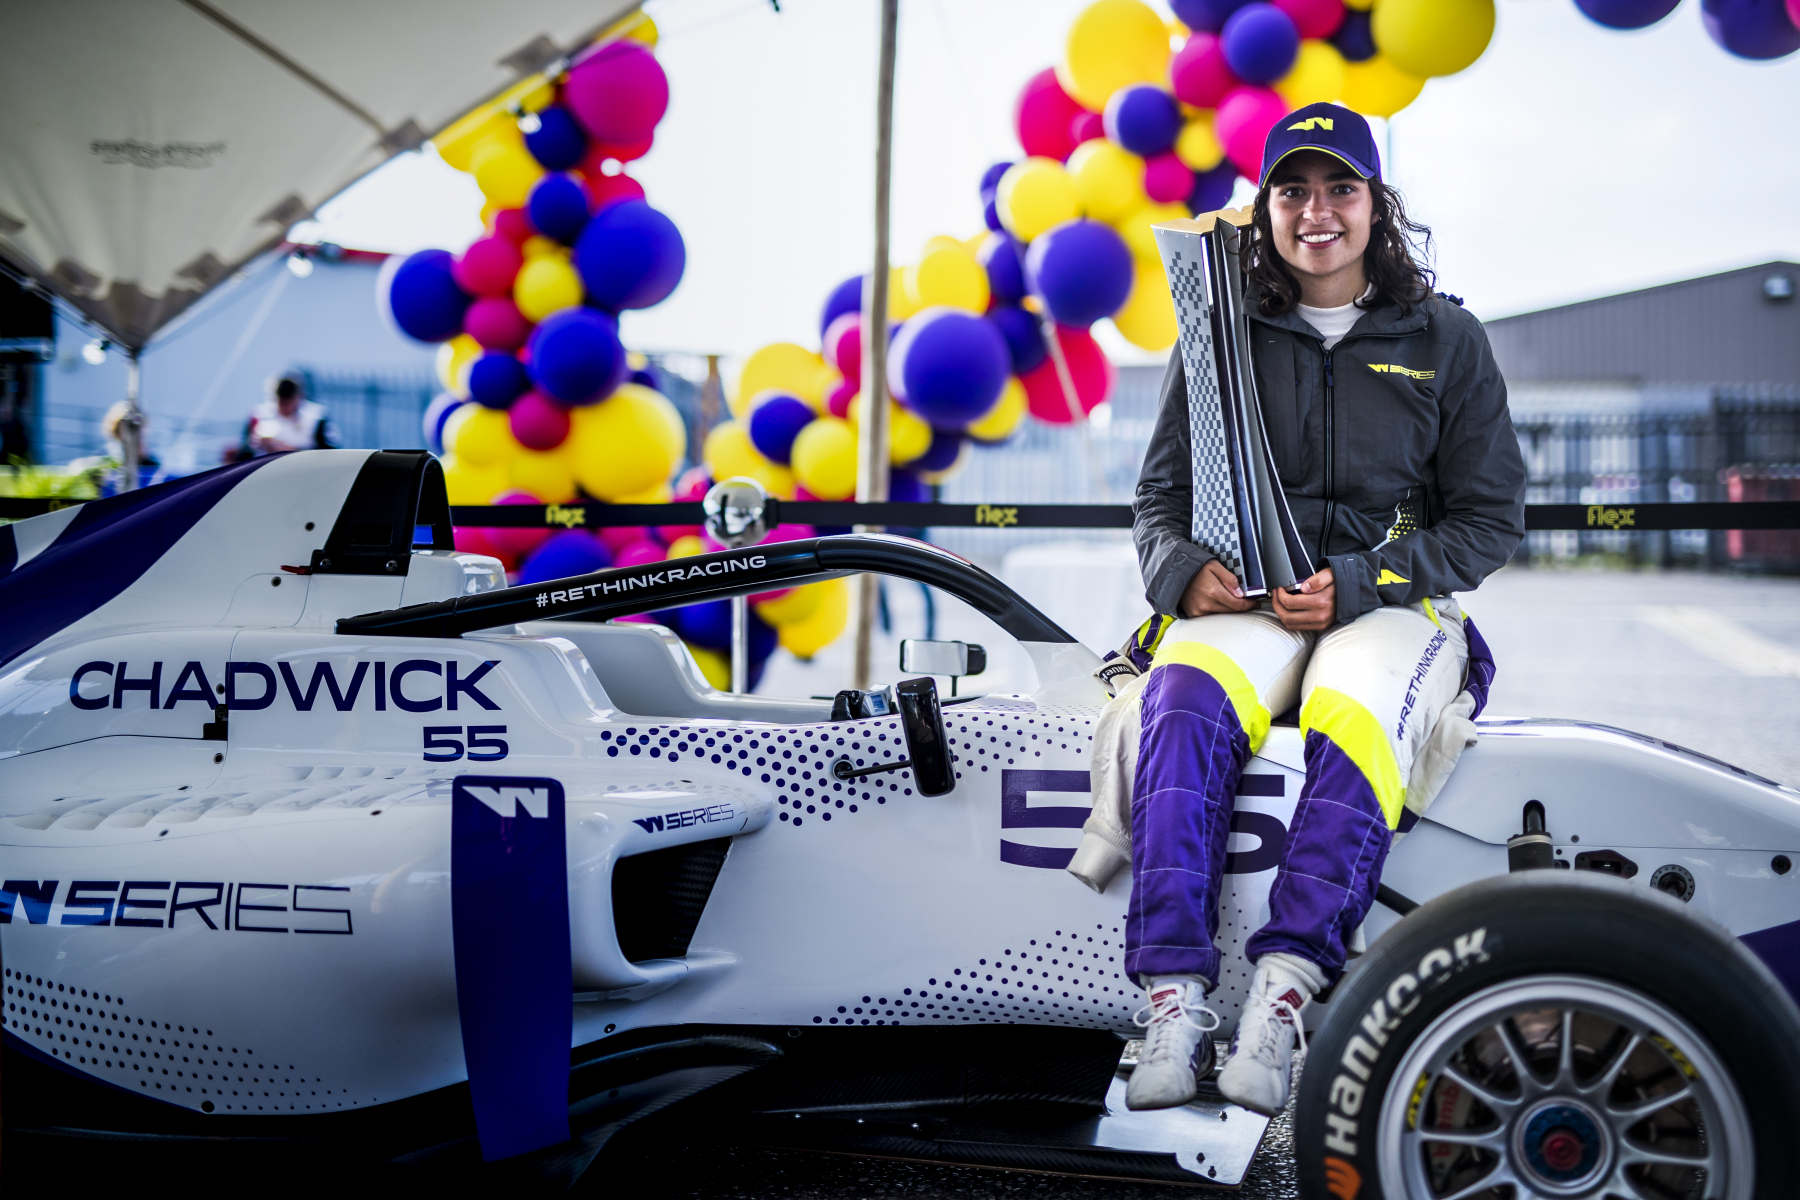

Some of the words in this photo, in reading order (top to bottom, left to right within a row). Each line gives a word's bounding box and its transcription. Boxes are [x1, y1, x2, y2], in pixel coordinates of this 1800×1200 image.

[1389, 364, 1436, 380] SERIES
[535, 555, 767, 608] #RETHINKRACING
[69, 658, 503, 713] CHADWICK
[1396, 629, 1448, 742] #RETHINKRACING
[422, 724, 510, 763] 55
[665, 803, 735, 831] SERIES
[60, 880, 354, 935] SERIES
